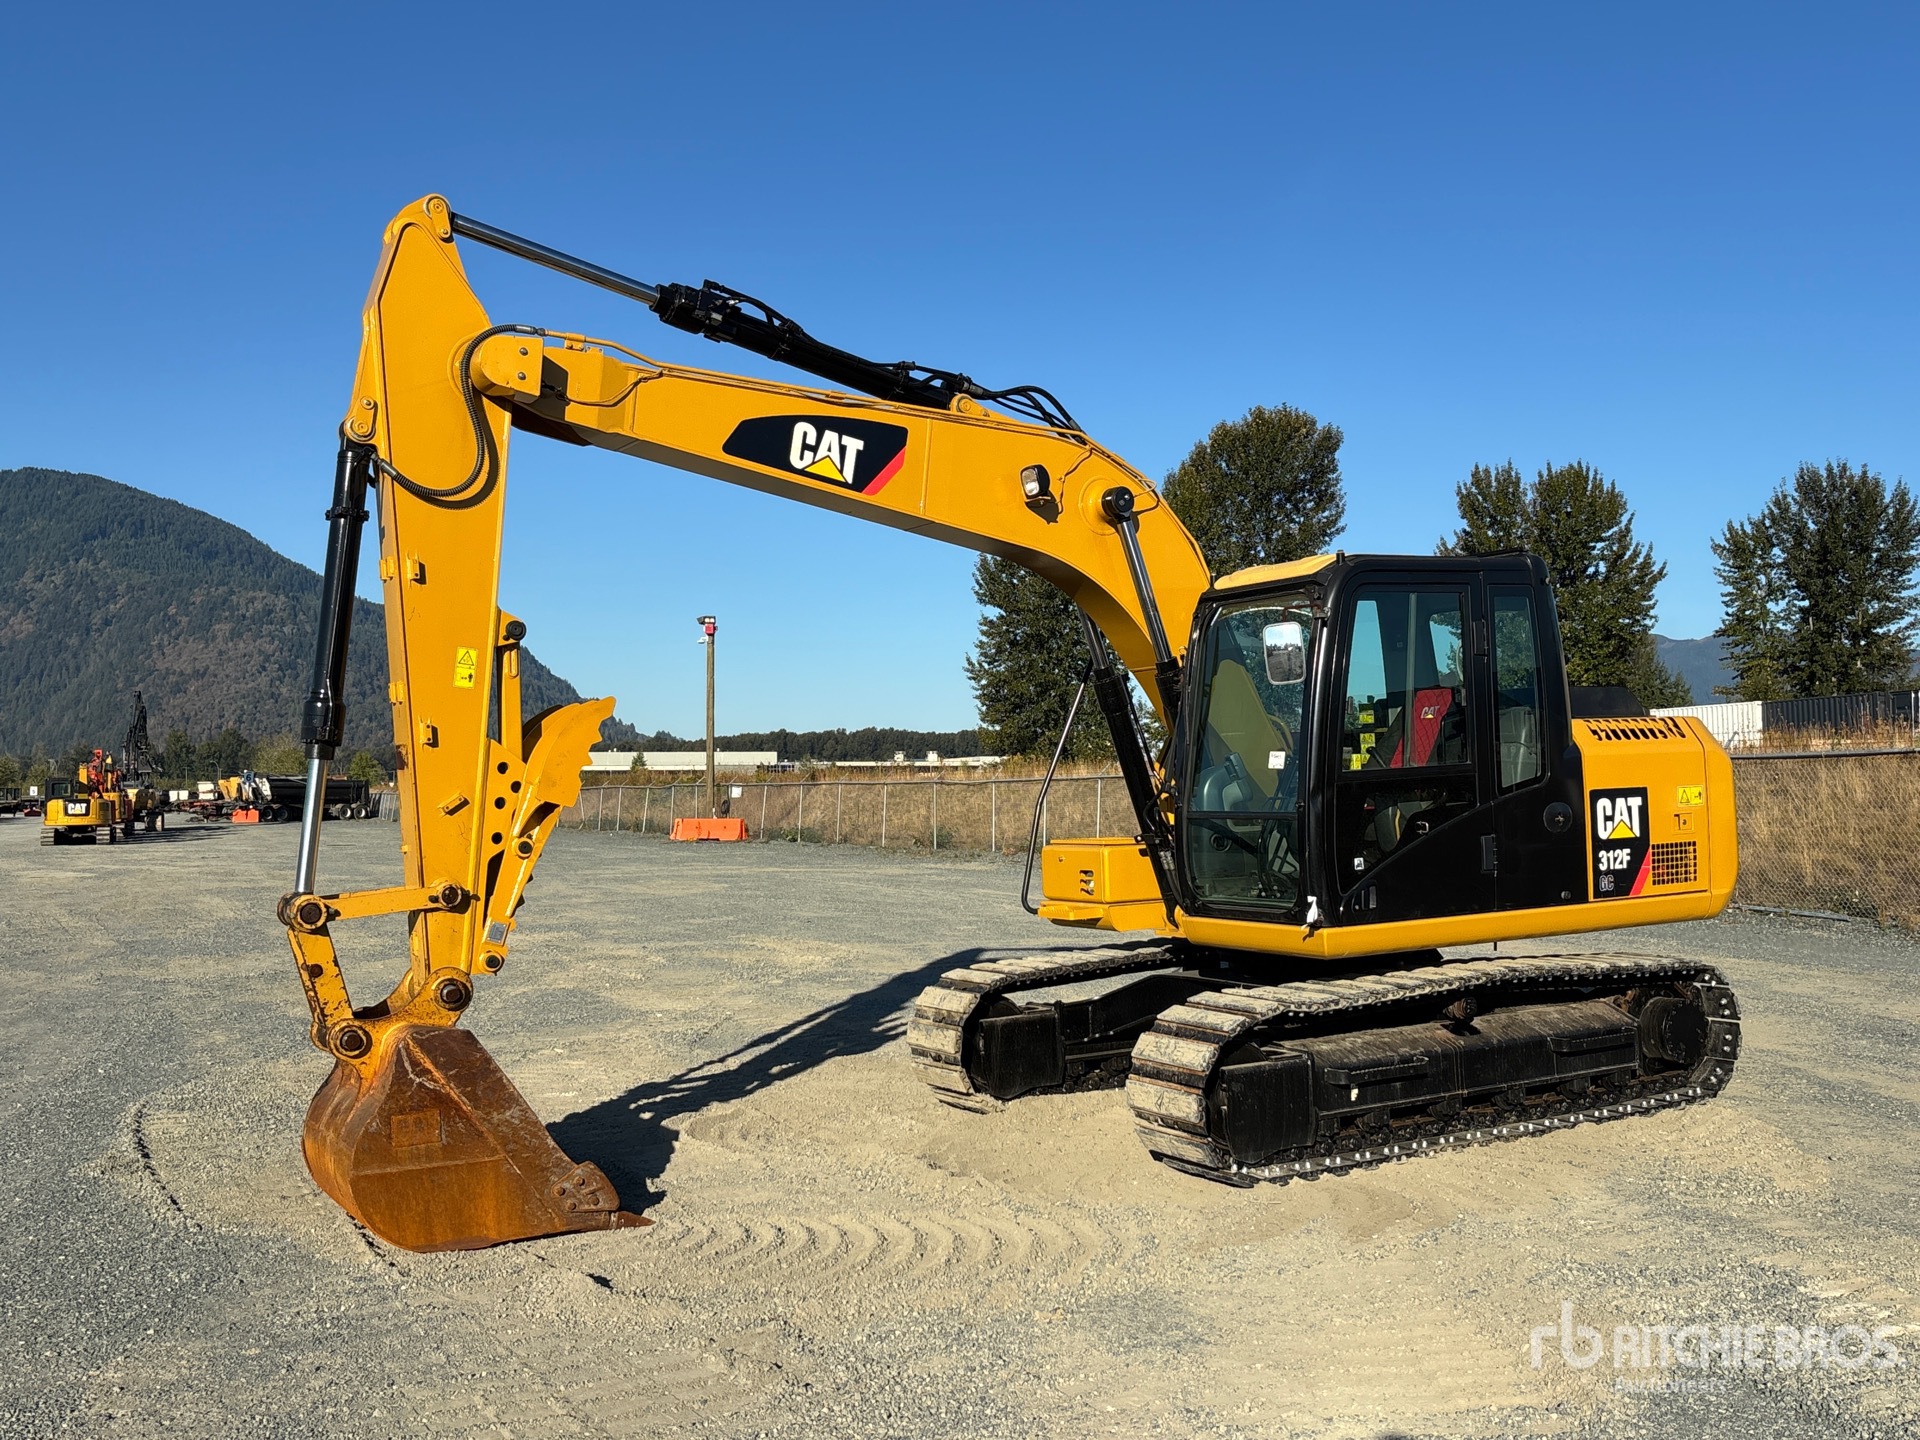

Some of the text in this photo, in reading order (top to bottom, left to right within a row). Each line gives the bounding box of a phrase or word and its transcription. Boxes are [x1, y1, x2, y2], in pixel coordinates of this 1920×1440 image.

[789, 421, 865, 484] CAT
[1420, 705, 1440, 719] CAT
[67, 802, 88, 815] CAT
[1596, 797, 1642, 840] CAT
[1598, 848, 1631, 871] 312F
[1599, 874, 1615, 891] GC
